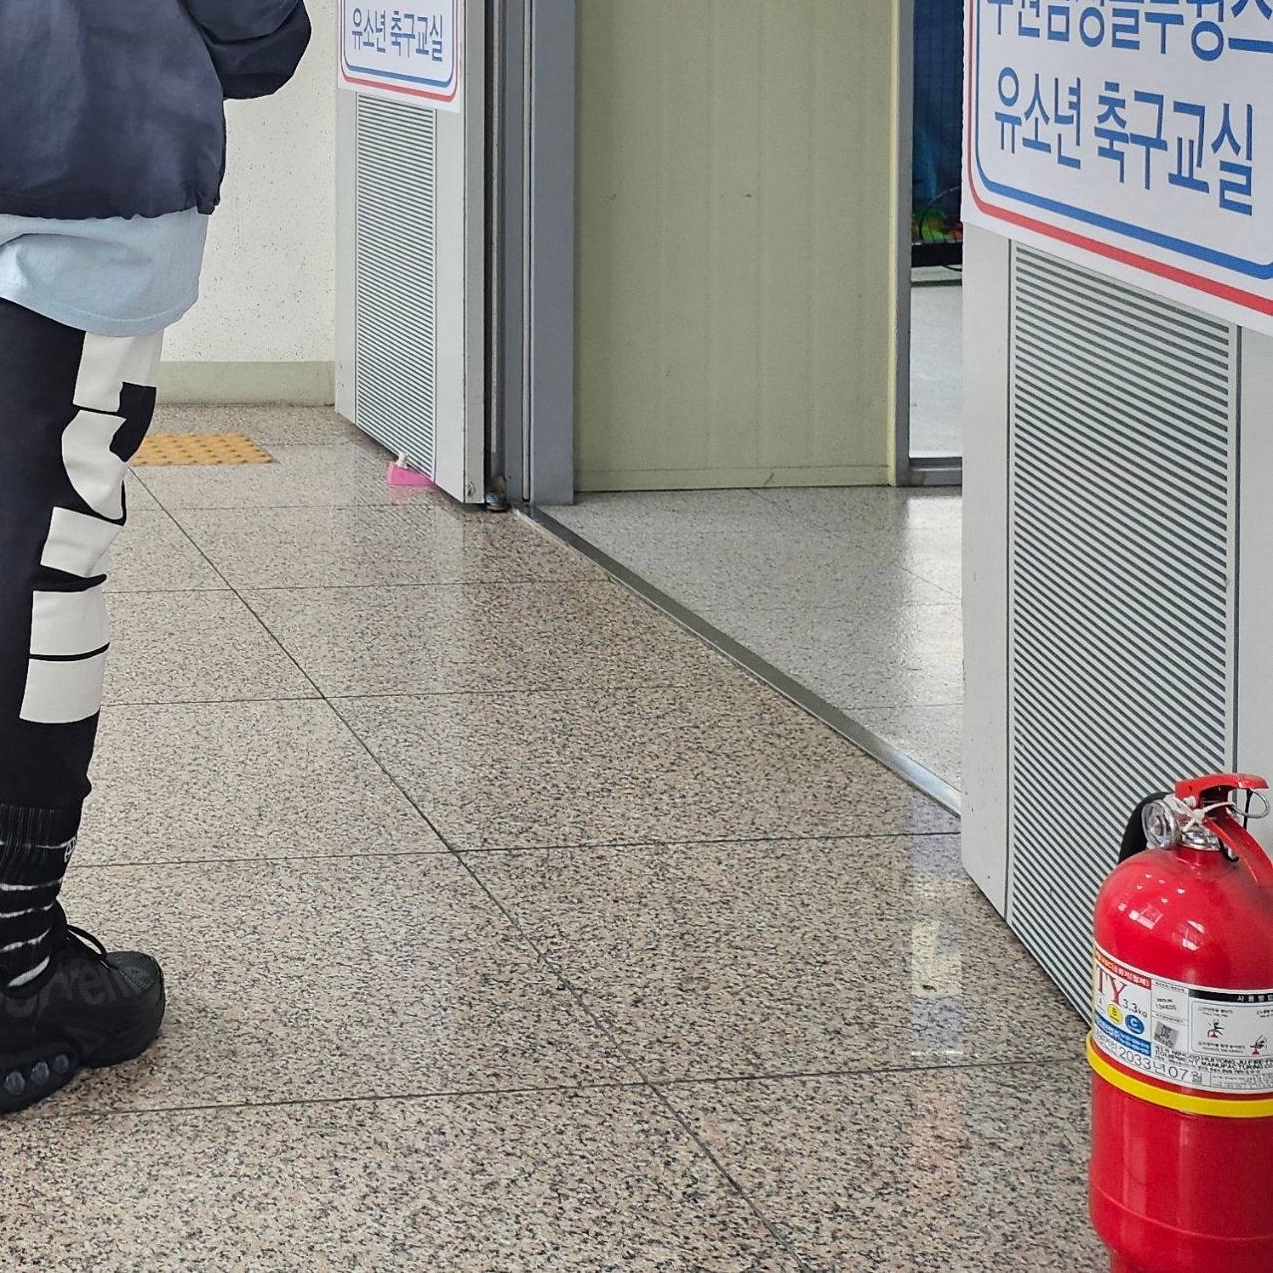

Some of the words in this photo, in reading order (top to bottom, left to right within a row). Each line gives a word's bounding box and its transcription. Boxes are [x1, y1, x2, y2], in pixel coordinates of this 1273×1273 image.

[352, 8, 386, 53] 유소년
[390, 10, 443, 62] 축구교실
[994, 67, 1081, 170] 유소년
[1094, 81, 1253, 216] 축구교실
[1123, 999, 1147, 1018] 3.3kg
[1130, 1017, 1139, 1028] C
